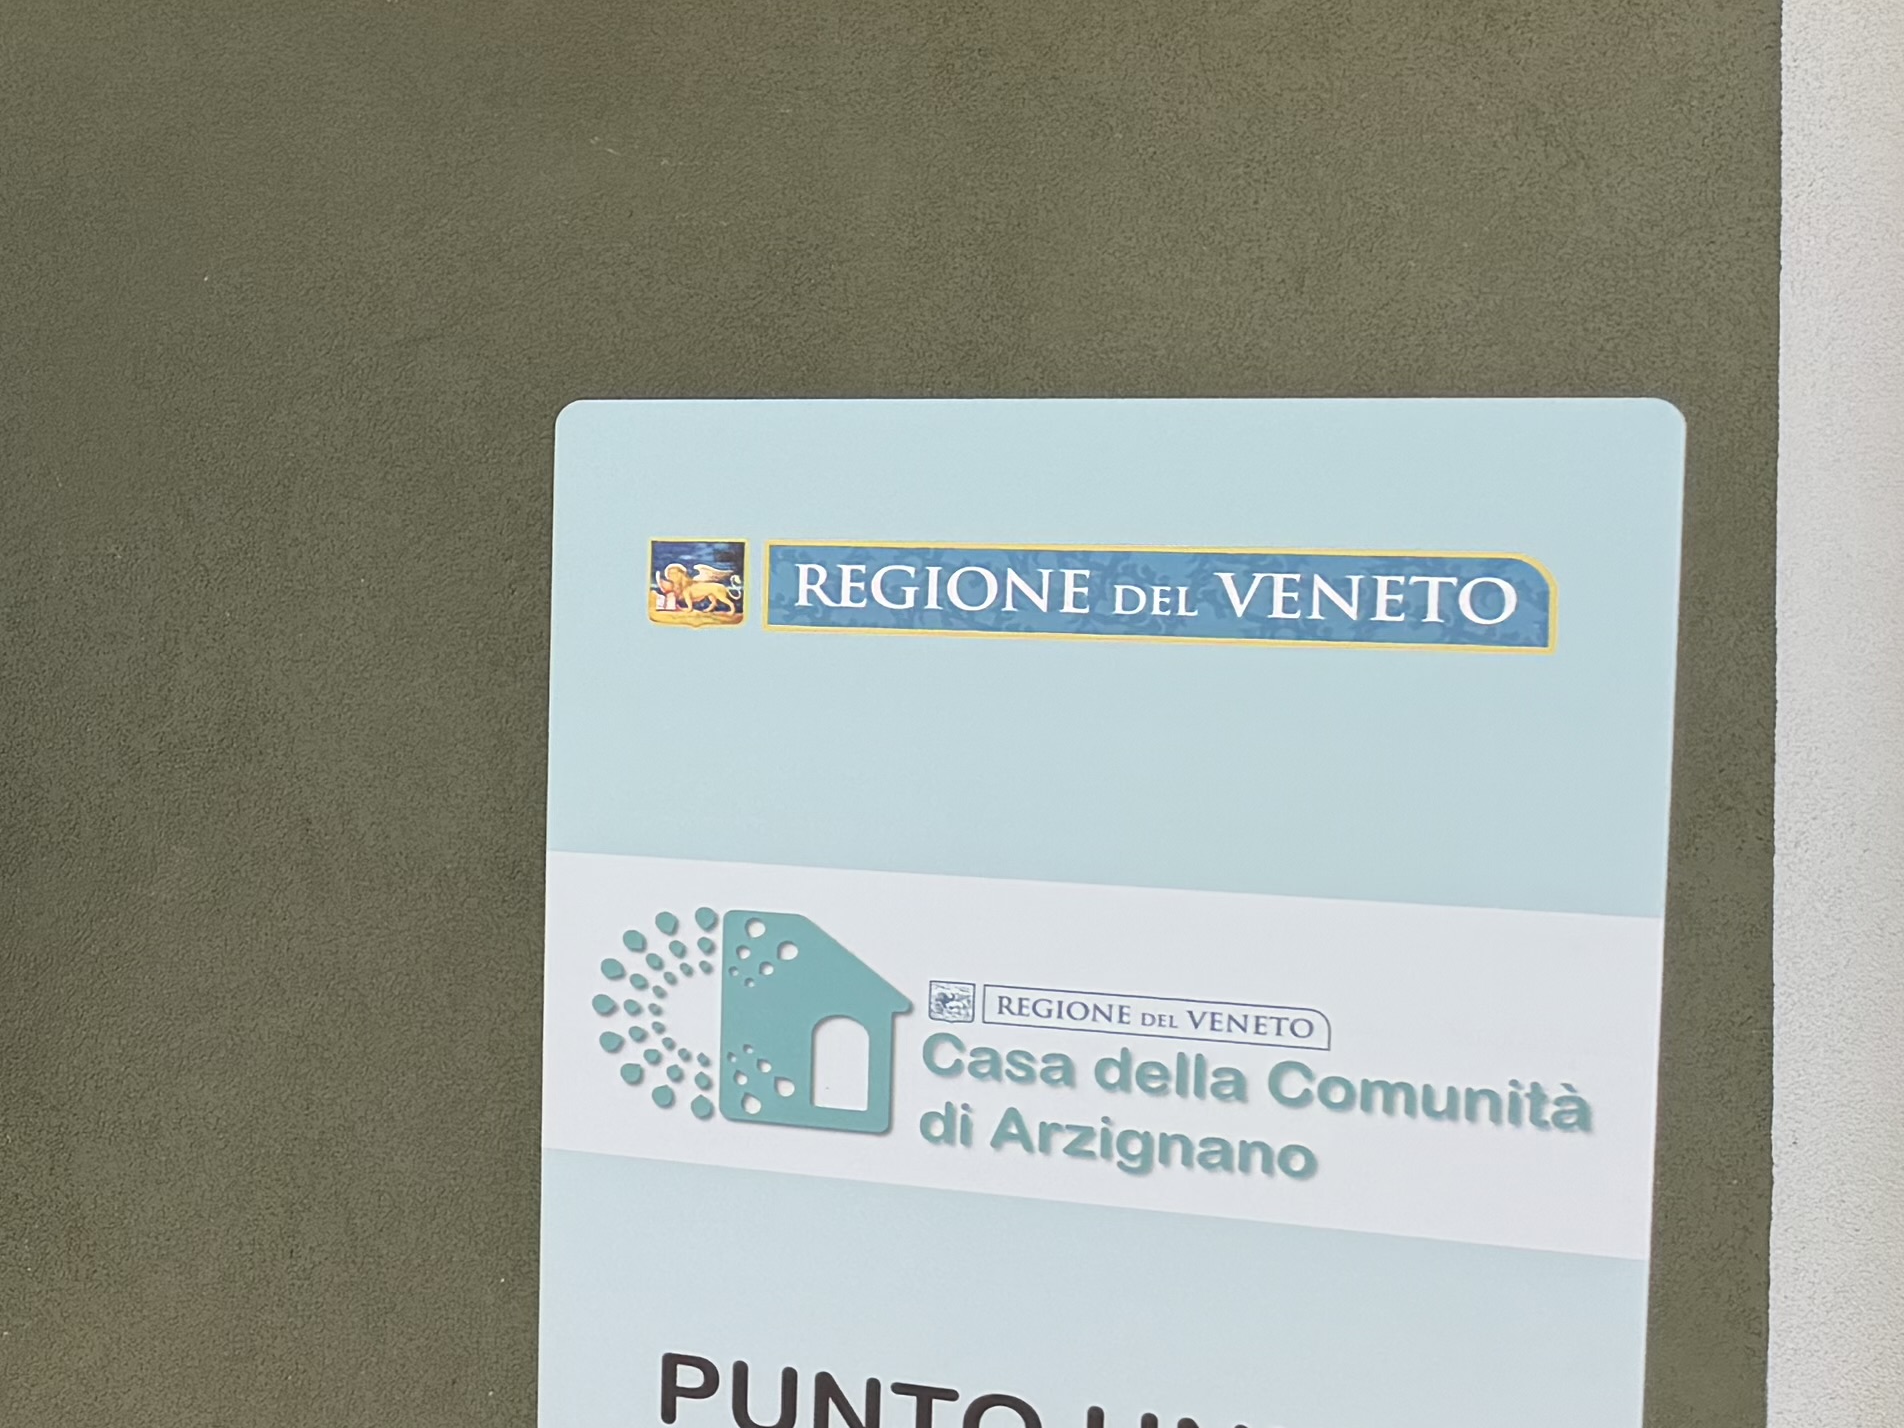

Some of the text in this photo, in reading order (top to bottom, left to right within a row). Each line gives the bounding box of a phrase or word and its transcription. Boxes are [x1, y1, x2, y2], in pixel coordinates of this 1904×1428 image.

[794, 561, 1518, 626] REGIONE DEL VENETO
[996, 995, 1316, 1040] REGIONE DEL VENETO
[922, 1031, 1593, 1134] Casa della Comunità
[919, 1101, 1319, 1180] di Arzignano
